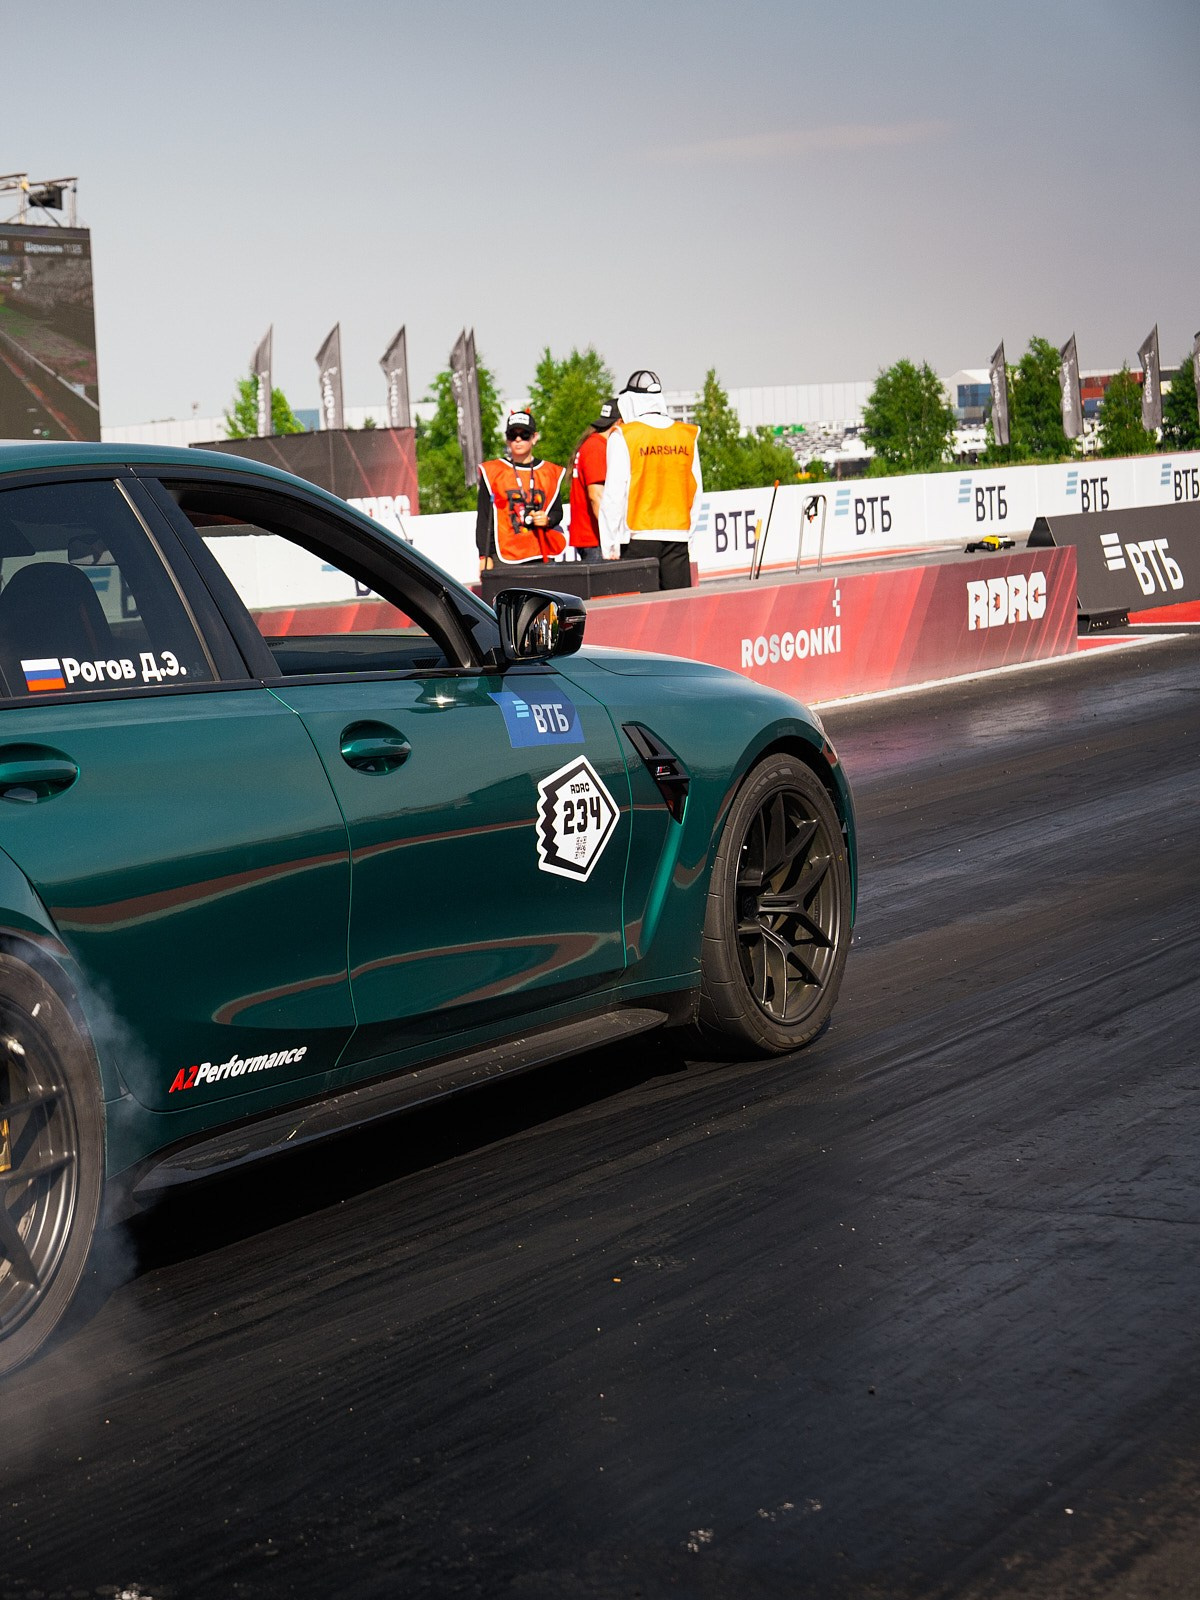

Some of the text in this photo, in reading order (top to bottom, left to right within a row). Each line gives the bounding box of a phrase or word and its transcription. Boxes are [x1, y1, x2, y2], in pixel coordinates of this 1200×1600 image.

[639, 445, 690, 457] MARSHAL
[1080, 477, 1110, 512] ВТБ
[1173, 468, 1200, 501] ВТБ
[346, 495, 411, 518] DRC
[854, 496, 892, 535] ВТБ
[974, 485, 1008, 522] ВТБ
[714, 510, 757, 553] ВТБ
[1124, 538, 1185, 596] ВТБ
[966, 571, 1047, 631] RDRC
[741, 625, 841, 668] ROSGONKI
[61, 651, 188, 684] Рогов Д.Э.
[530, 703, 570, 733] ВТБ
[570, 782, 590, 794] RDRC
[563, 796, 601, 835] 234
[168, 1046, 308, 1093] A2Performance
